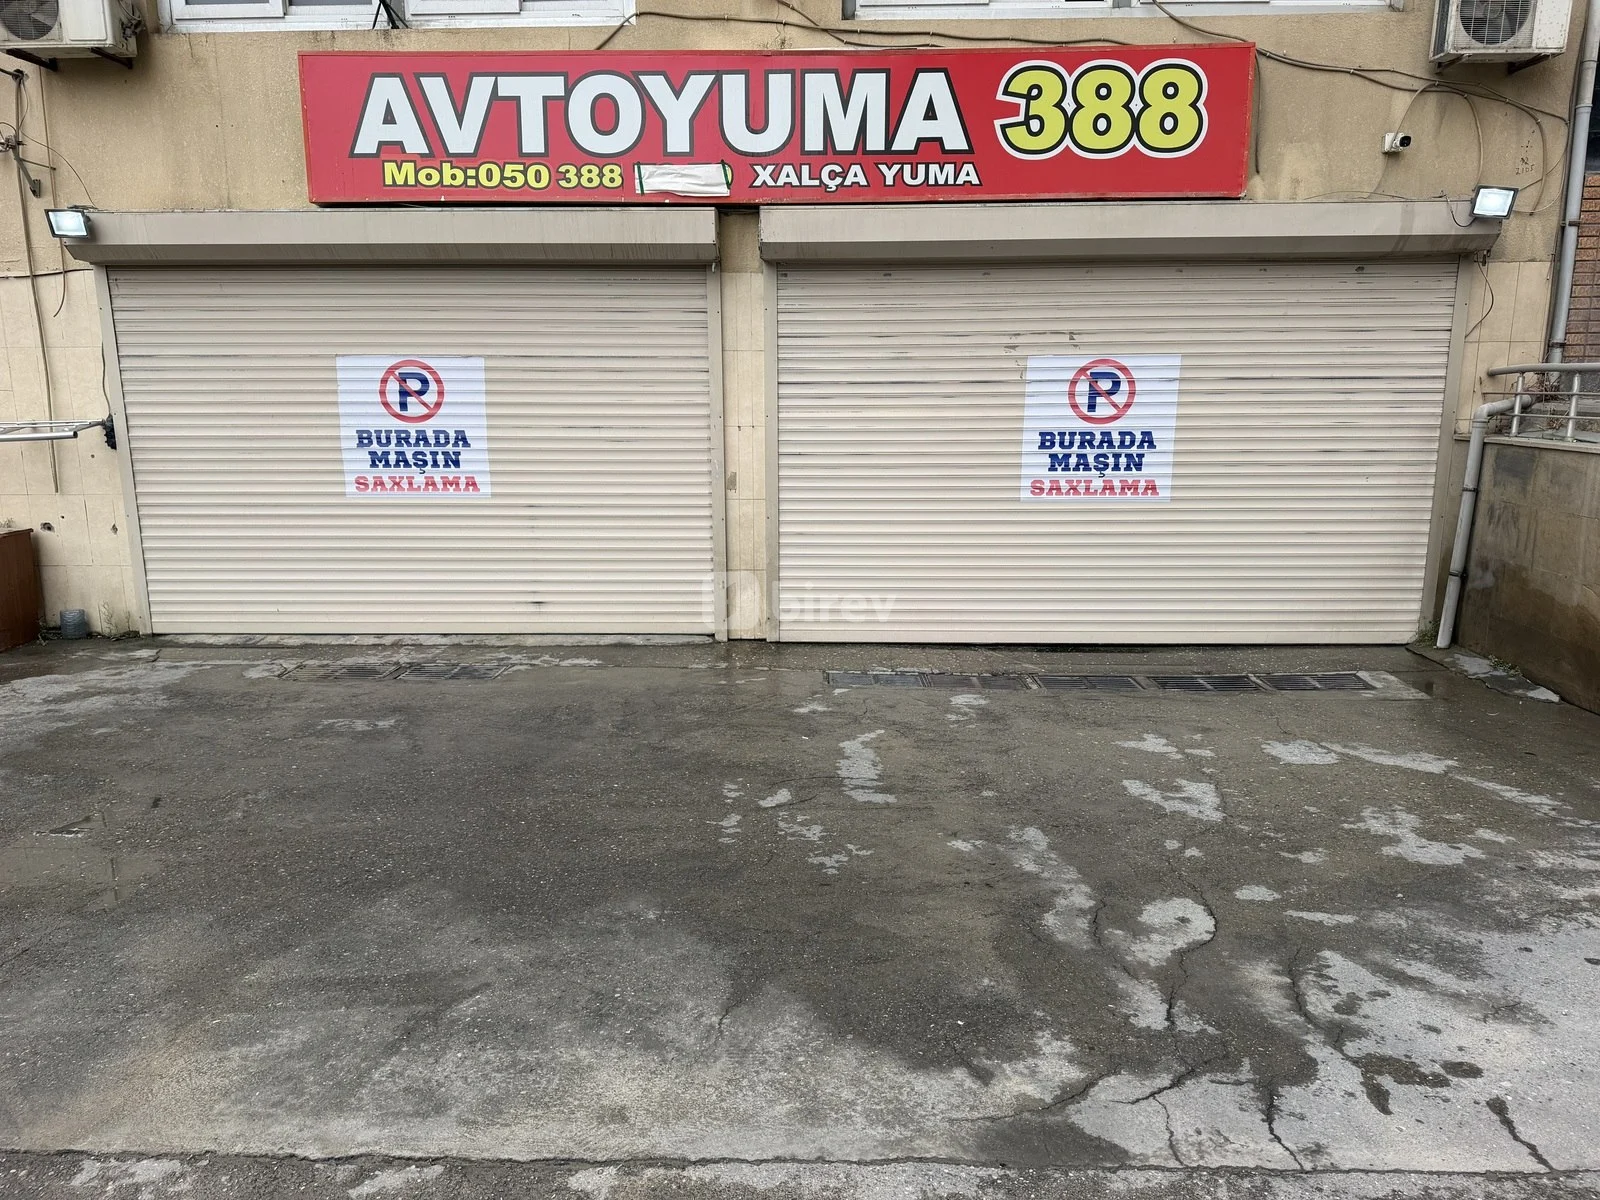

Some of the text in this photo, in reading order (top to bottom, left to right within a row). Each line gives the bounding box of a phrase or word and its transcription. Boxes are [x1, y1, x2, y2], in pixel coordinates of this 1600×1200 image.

[350, 60, 1207, 158] AVTOYUMA 388
[384, 162, 550, 190] Mob:050
[558, 163, 623, 189] 388
[752, 163, 868, 191] XALÇA
[877, 162, 982, 187] YUMA
[355, 429, 471, 448] BURADA
[1037, 431, 1157, 450] BURADA
[368, 450, 461, 475] MAŞIN
[1048, 453, 1145, 478] MAŞIN
[354, 475, 481, 492] SAXLAMA
[1030, 479, 1159, 496] SAXLAMA
